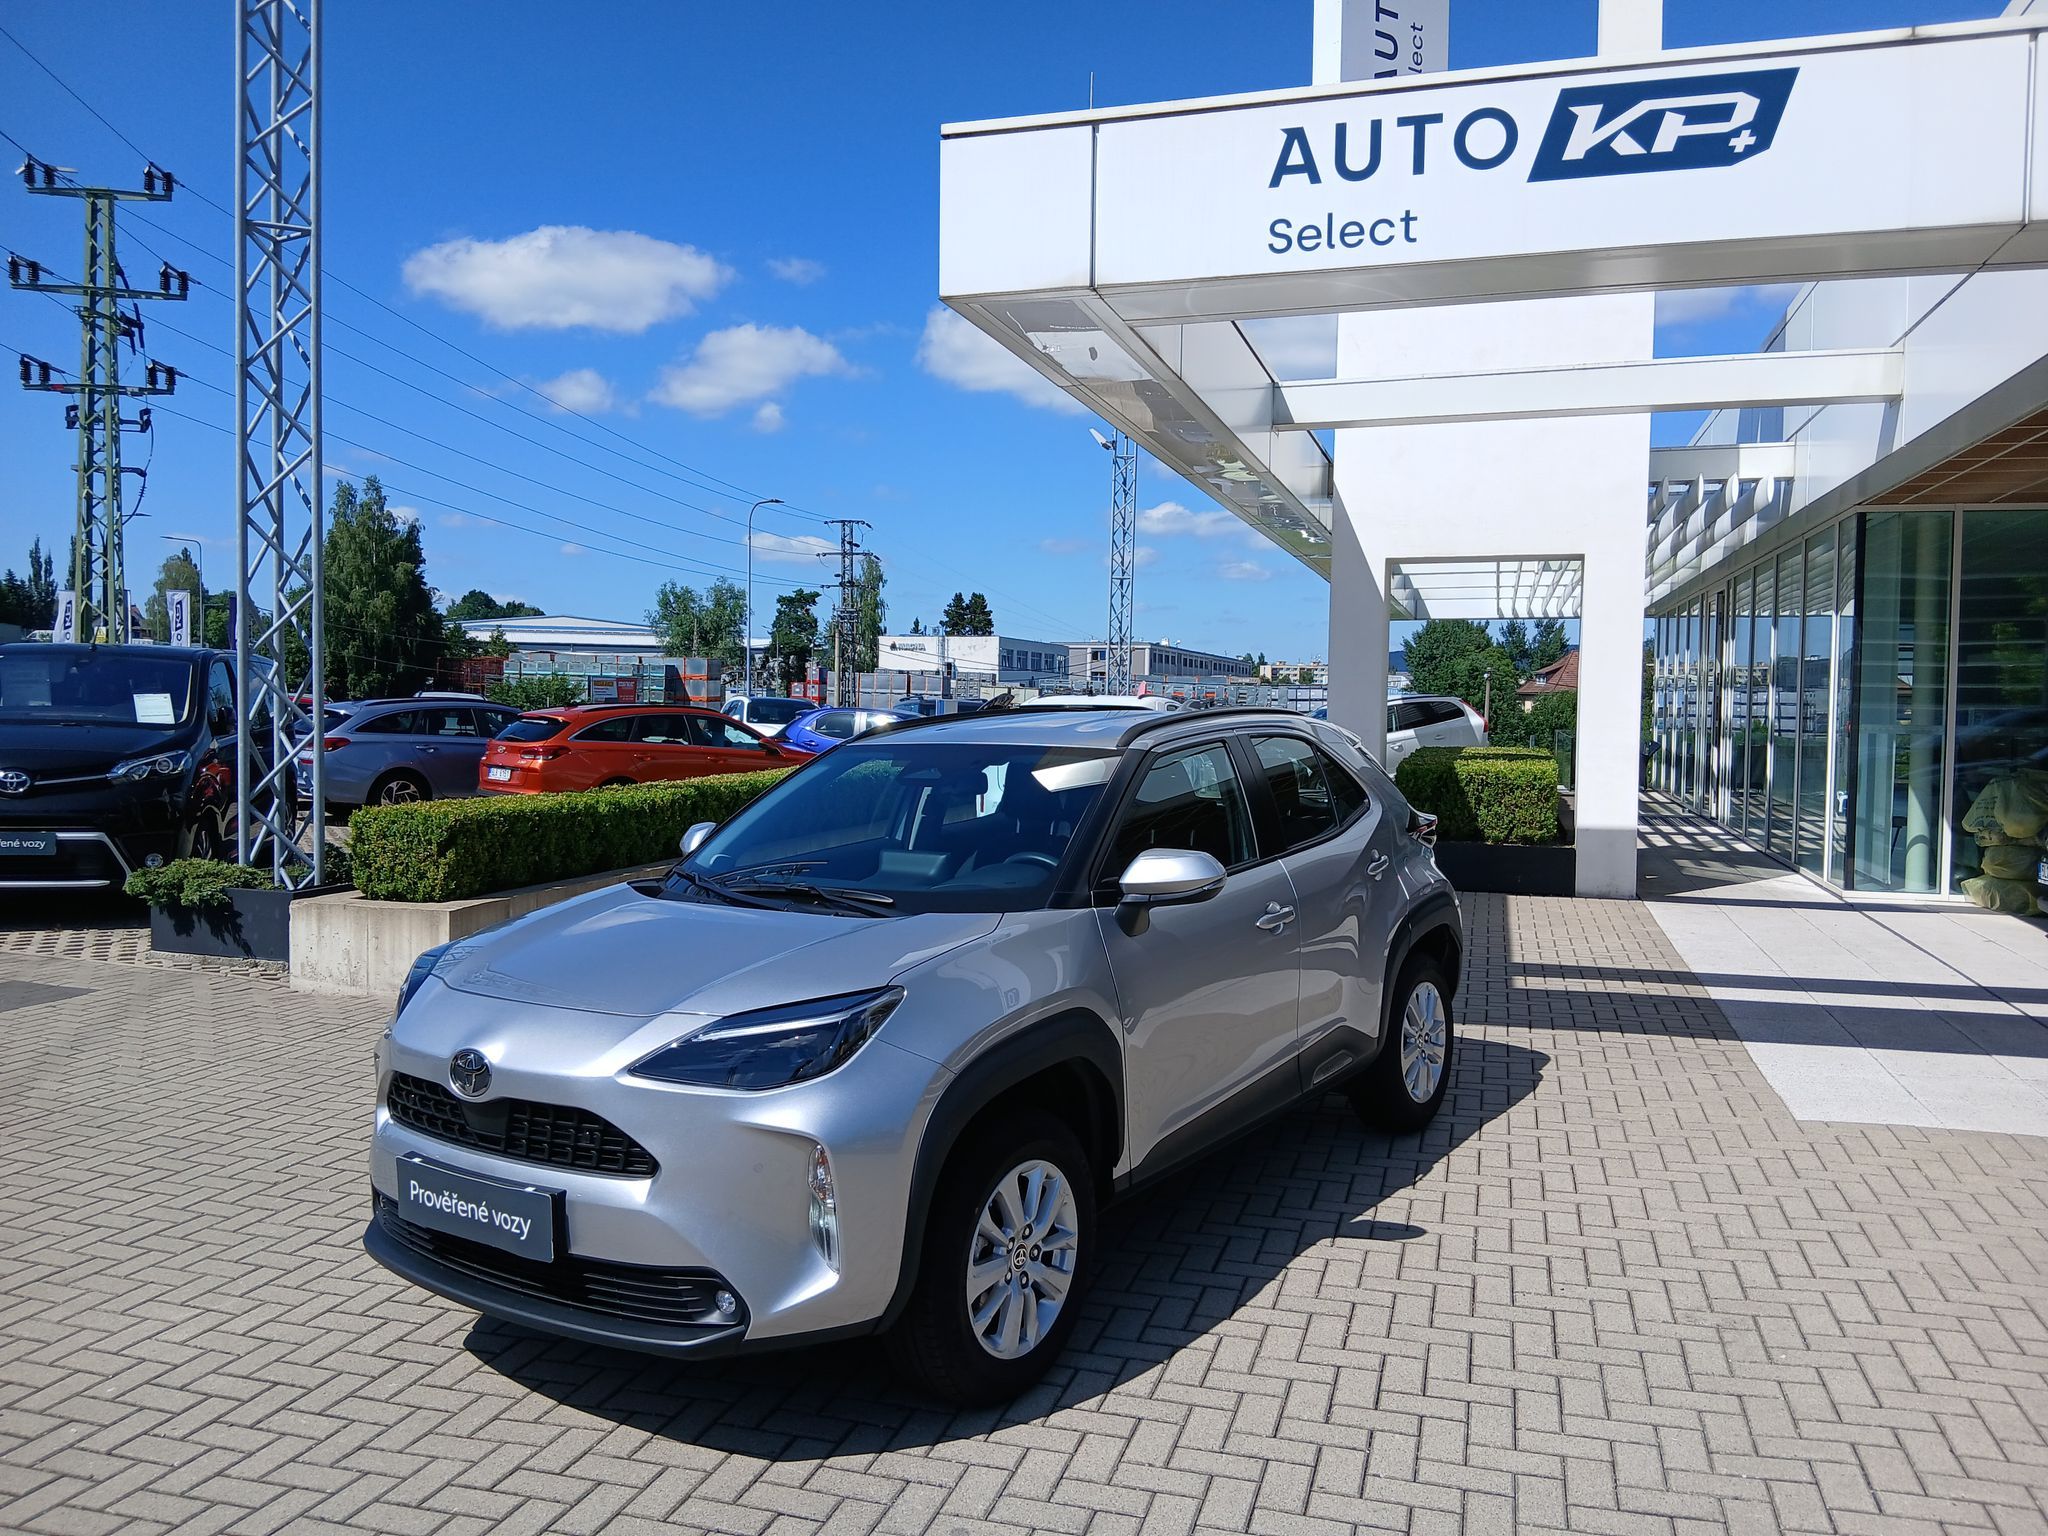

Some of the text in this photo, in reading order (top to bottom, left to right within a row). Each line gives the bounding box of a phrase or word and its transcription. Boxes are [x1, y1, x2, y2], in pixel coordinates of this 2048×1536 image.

[1268, 107, 1518, 188] AUTO
[1268, 209, 1418, 254] Select
[22, 840, 46, 850] vozy
[410, 1180, 532, 1241] Prověřené vozy
